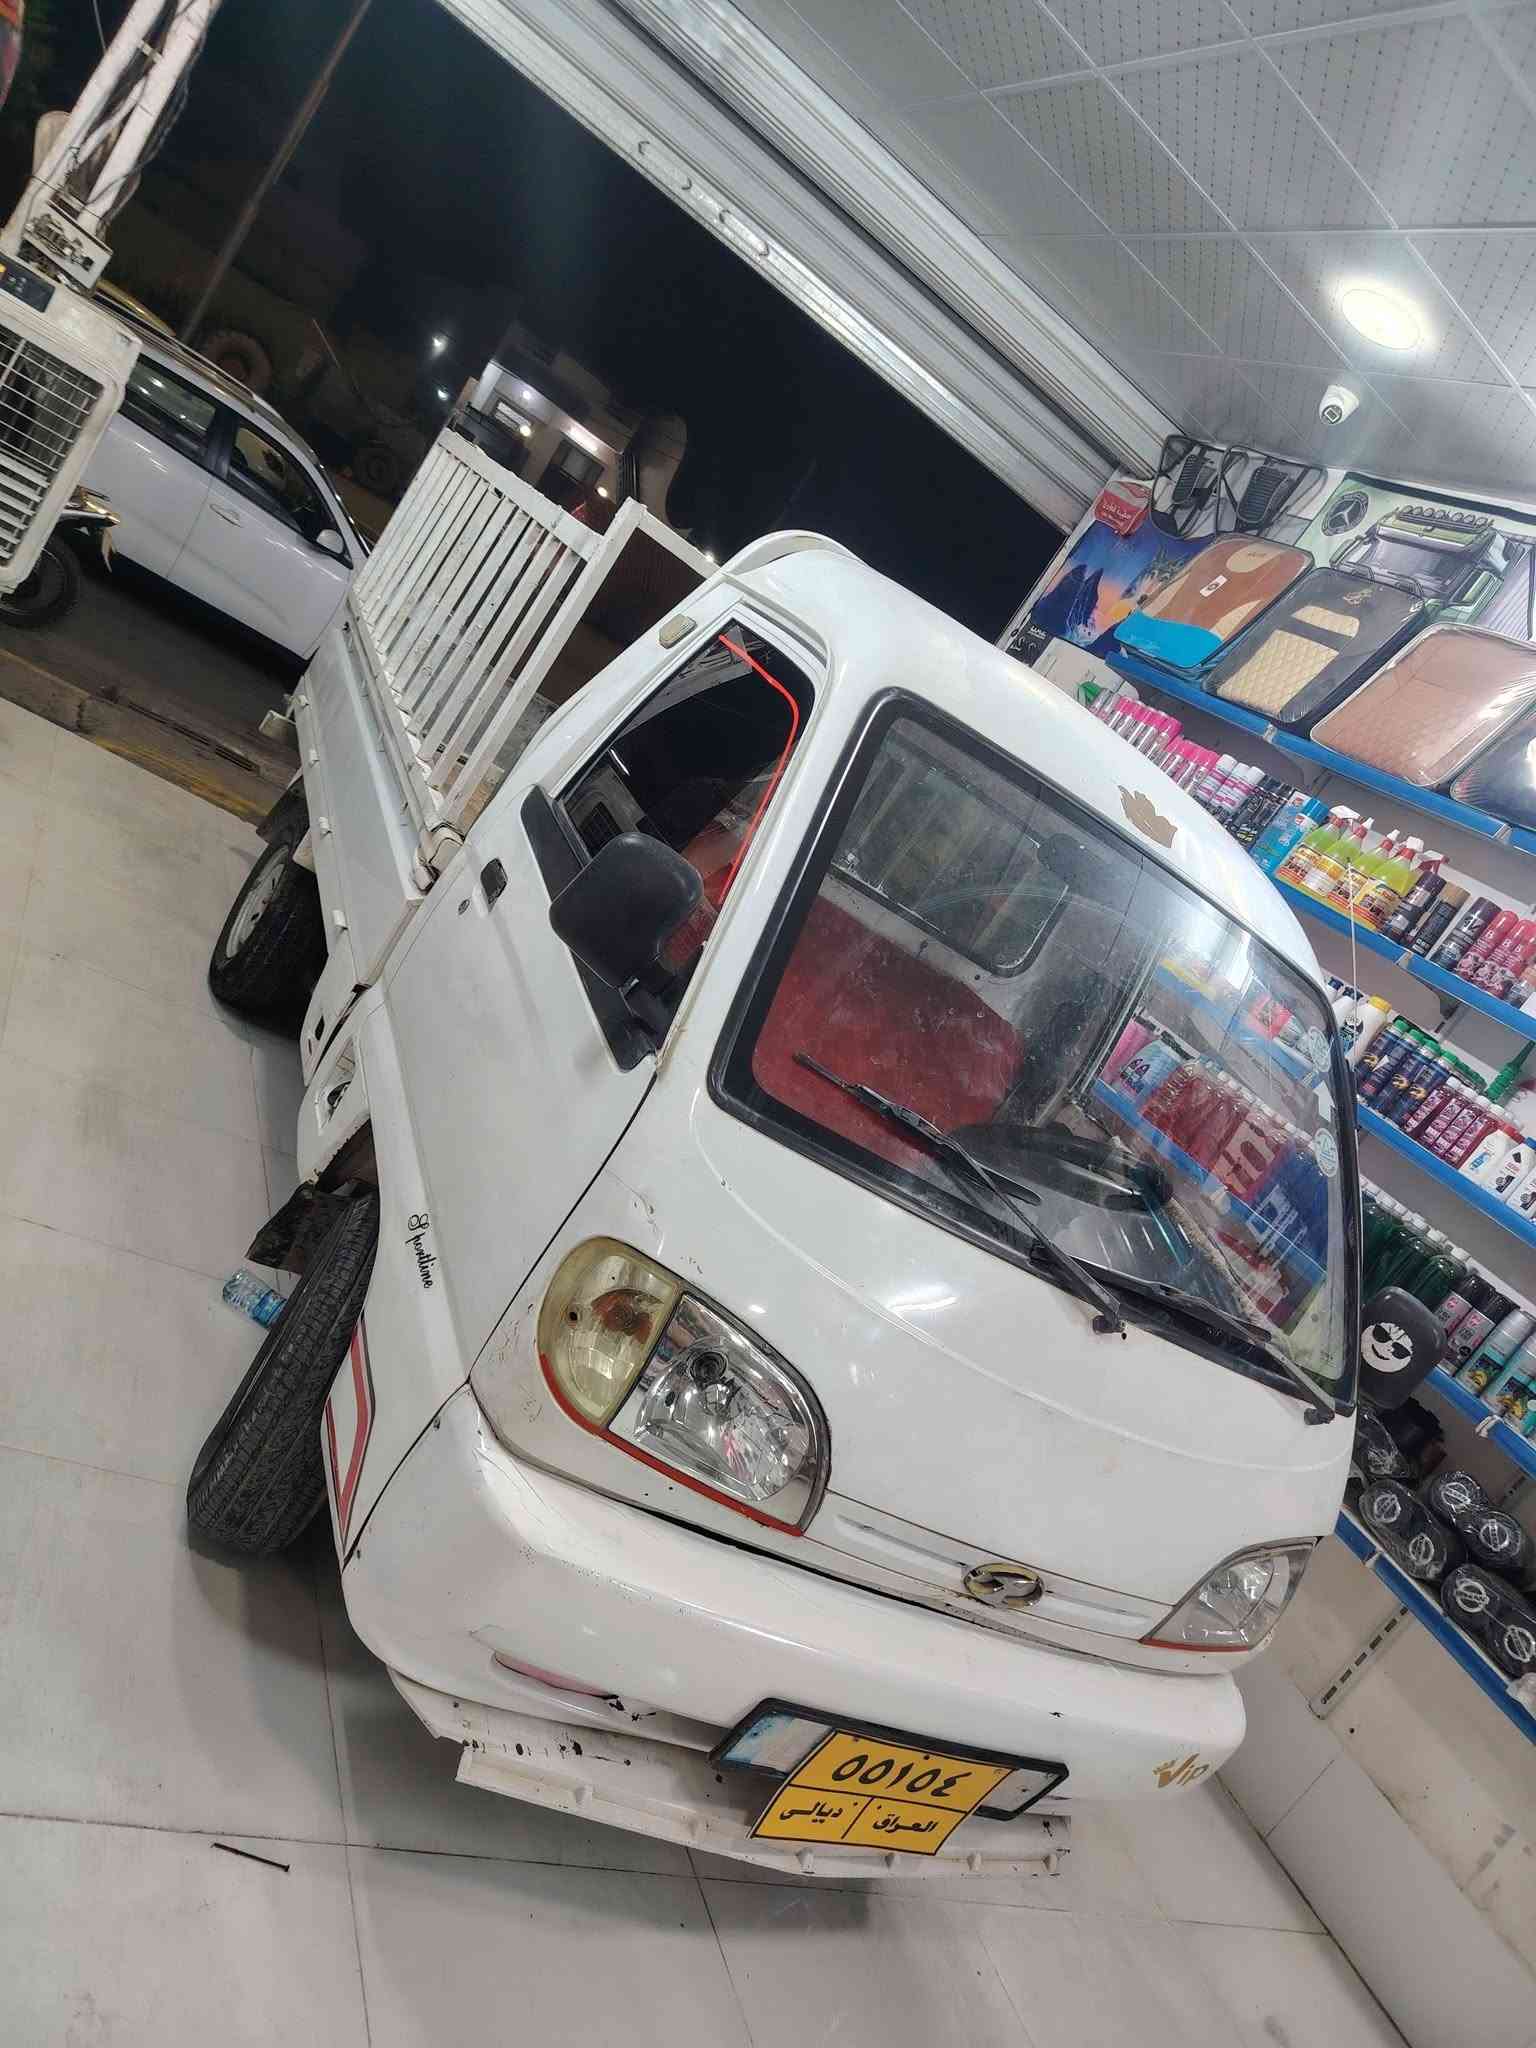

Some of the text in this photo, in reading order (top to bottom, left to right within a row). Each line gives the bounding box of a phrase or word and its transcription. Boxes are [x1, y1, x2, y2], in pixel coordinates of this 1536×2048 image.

[405, 1213, 437, 1288] Sportline
[831, 1755, 972, 1797] ٥٥١٥٤
[872, 1814, 939, 1833] العراق
